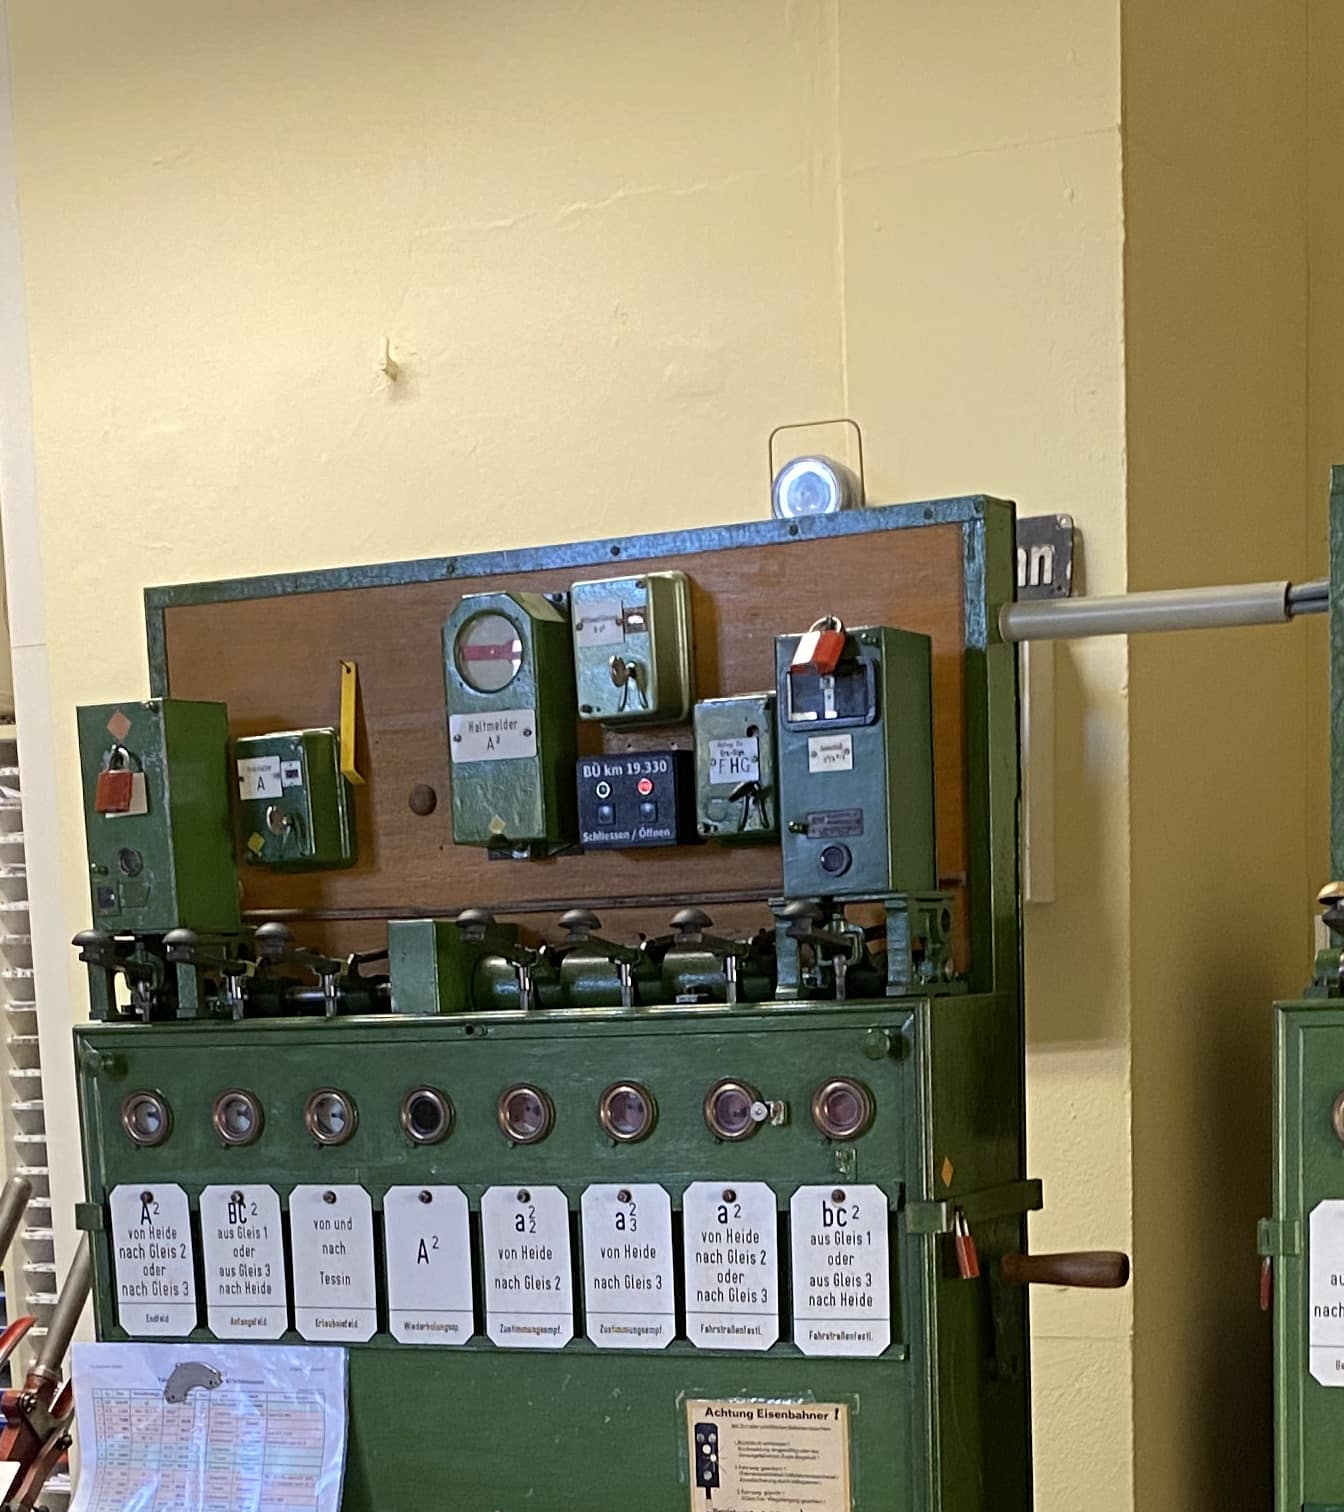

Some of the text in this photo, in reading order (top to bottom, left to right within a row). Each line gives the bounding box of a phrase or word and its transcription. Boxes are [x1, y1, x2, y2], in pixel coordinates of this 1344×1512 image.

[468, 718, 518, 733] Haltmelder
[583, 759, 667, 778] BÜ km 19.330
[256, 775, 266, 792] A
[582, 826, 671, 843] Schliessen / Öffnen
[313, 1216, 353, 1231] von und
[127, 1226, 177, 1240] von Heide
[217, 1225, 268, 1240] aus Gleis 1
[701, 1227, 760, 1245] von Heide
[810, 1230, 871, 1246] aus Gleis 1
[119, 1243, 187, 1260] nach Gleis 2
[232, 1244, 256, 1258] oder
[322, 1240, 346, 1256] nach
[498, 1244, 553, 1261] von Heide
[600, 1243, 656, 1259] von Heide
[695, 1248, 767, 1266] nach Gleis 2
[827, 1250, 855, 1266] oder
[142, 1262, 167, 1277] oder
[219, 1263, 271, 1278] aus Gleis 3
[716, 1268, 745, 1285] oder
[319, 1270, 351, 1286] Tessin
[494, 1274, 561, 1291] nach Gleis 2
[593, 1273, 663, 1290] nach Gleis 3
[809, 1271, 872, 1288] aus Gleis 3
[121, 1280, 189, 1297] nach Gleis 3
[218, 1280, 272, 1295] nach Heide
[696, 1286, 768, 1304] nach Gleis 3
[808, 1291, 873, 1308] nach Heide
[705, 1407, 840, 1421] Achtung Eisenbahner !
